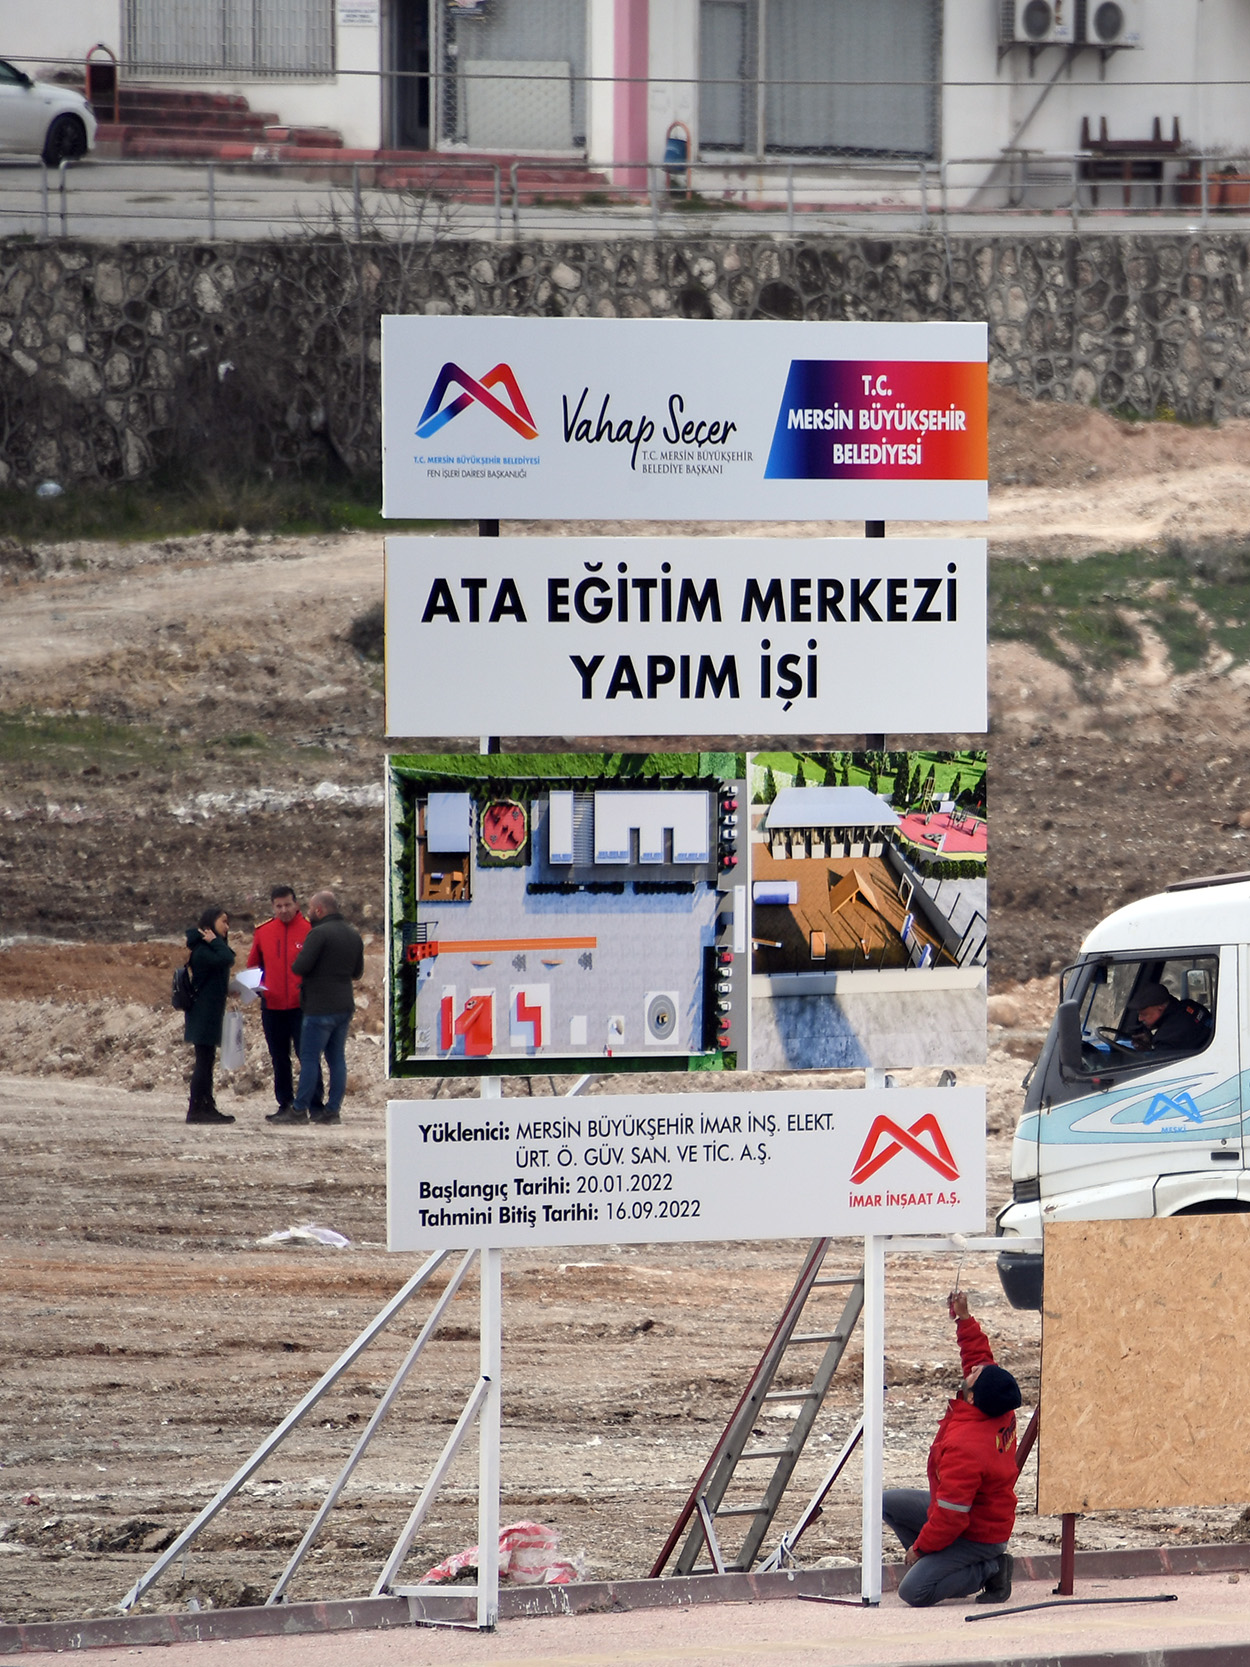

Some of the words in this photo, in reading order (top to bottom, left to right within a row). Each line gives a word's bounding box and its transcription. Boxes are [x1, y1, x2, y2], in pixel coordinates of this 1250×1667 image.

[862, 375, 892, 396] T.C.
[563, 387, 654, 470] Vahap
[663, 394, 737, 448] Seçer
[787, 402, 853, 430] MERSİN
[859, 402, 966, 436] BÜYÜKŞEHİR
[427, 455, 455, 464] MERSİN
[456, 455, 501, 466] BÜYÜKŞEHİR
[502, 456, 540, 465] BELEDİYESİ
[642, 451, 657, 461] T.C.
[660, 450, 694, 461] MERSİN
[697, 449, 754, 463] BÜYÜKŞEHİR
[833, 437, 922, 465] BELEDİYESİ
[427, 469, 441, 478] FEN
[442, 469, 460, 479] İŞLERİ
[461, 468, 486, 479] DAİRESİ
[487, 468, 527, 479] BAŞKANLIĞI
[642, 463, 683, 474] BELEDİYE
[686, 464, 723, 476] BAŞKANI
[421, 577, 529, 624] ATA
[547, 561, 723, 625] EĞİTİM
[740, 561, 958, 624] MERKEZİ
[568, 654, 741, 700] YAPIM
[760, 638, 818, 713] İŞİ
[418, 1121, 510, 1143] Yüklenici:
[516, 1116, 581, 1140] MERSİN
[588, 1112, 694, 1141] BÜYÜKŞEHİR
[700, 1112, 741, 1134] İMAR
[748, 1111, 781, 1136] İNŞ.
[787, 1113, 835, 1132] ELEKT.
[516, 1146, 550, 1168] ÜRT.
[557, 1144, 577, 1167] Ö.
[584, 1145, 624, 1166] GÜV.
[631, 1146, 671, 1165] SAN.
[677, 1145, 698, 1163] VE
[703, 1140, 734, 1163] TİC.
[740, 1143, 771, 1165] A.Ş.
[419, 1179, 508, 1203] Başlangıç
[514, 1176, 570, 1196] Tarihi:
[577, 1173, 673, 1194] 20.01.2022
[849, 1192, 882, 1208] İMAR
[886, 1190, 933, 1209] İNŞAAT
[937, 1191, 961, 1205] A.Ş.
[419, 1205, 492, 1227] Tahmini
[499, 1204, 537, 1228] Bitiş
[543, 1202, 599, 1223] Tarihi:
[606, 1199, 701, 1221] 16.09.2022
